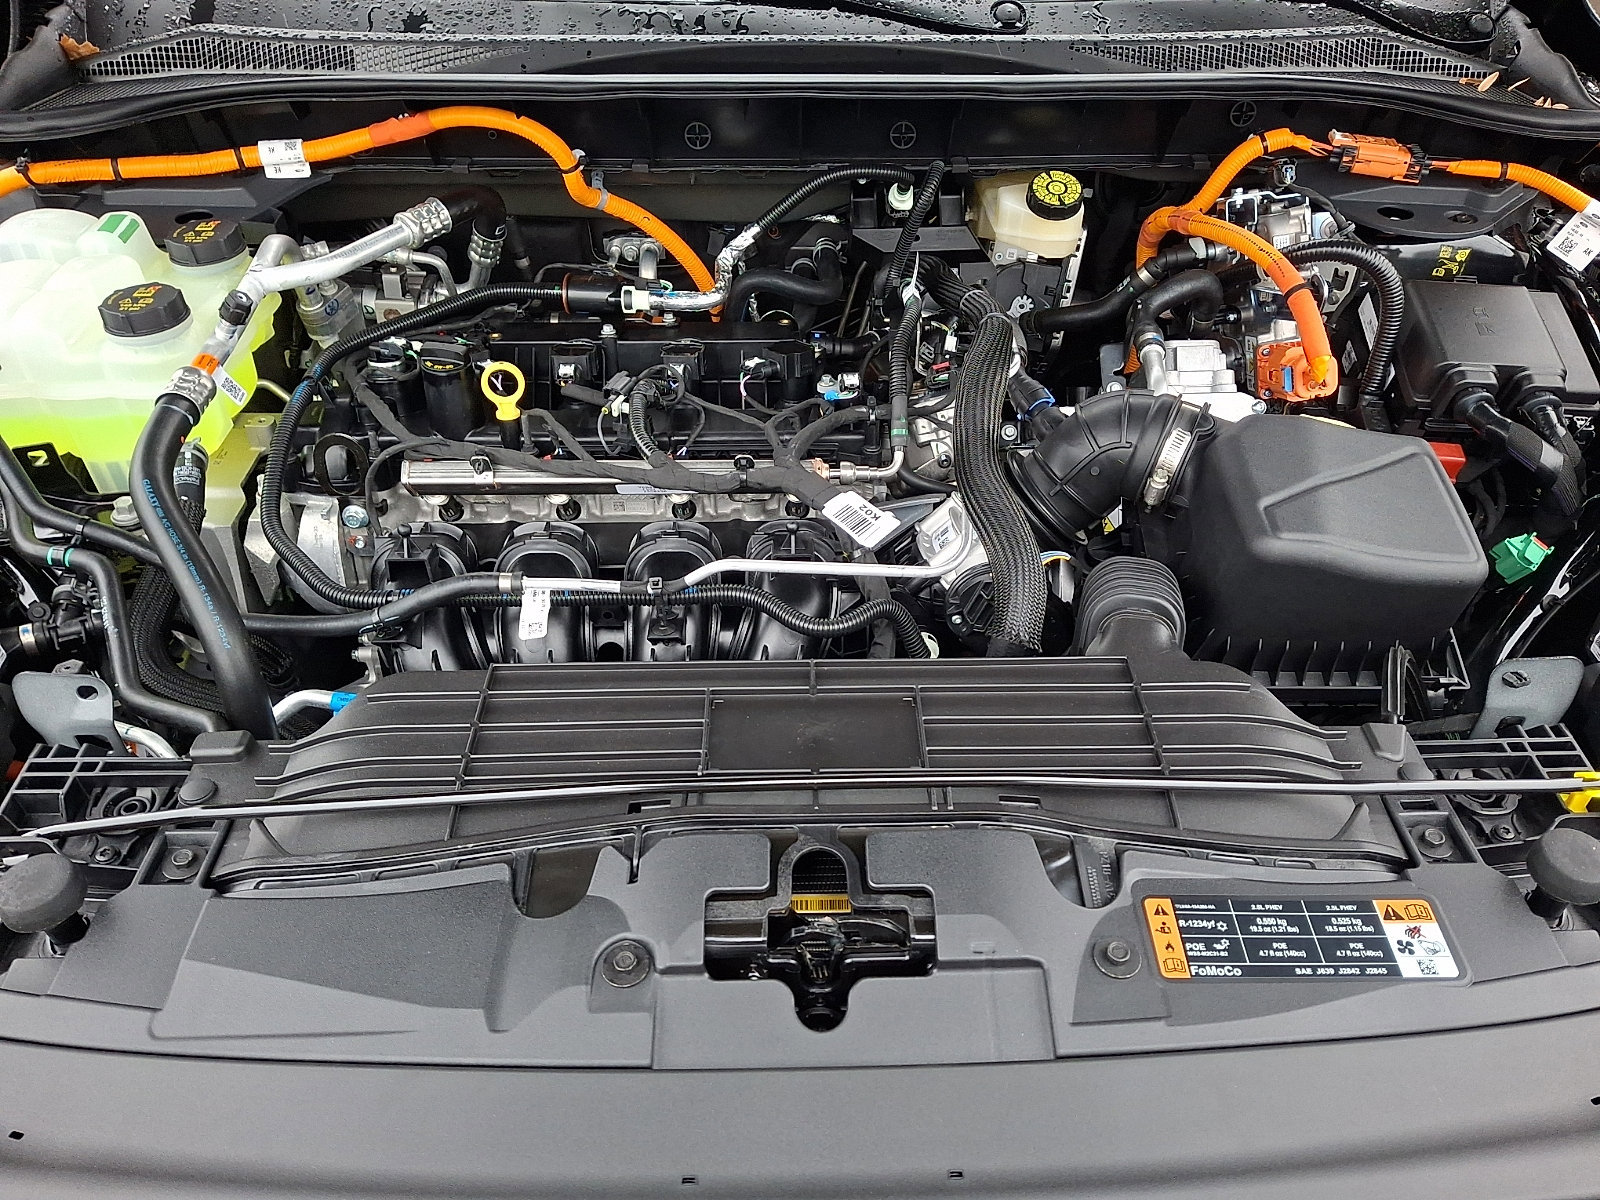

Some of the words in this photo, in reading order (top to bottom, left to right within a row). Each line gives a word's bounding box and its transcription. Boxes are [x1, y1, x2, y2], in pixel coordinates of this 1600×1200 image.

[859, 504, 881, 521] K02
[142, 479, 161, 507] GALAXY
[167, 527, 181, 544] HOSE
[185, 560, 202, 584] (19mm)
[199, 584, 214, 611] R-134a
[1179, 919, 1216, 930] R-1234yf
[1276, 917, 1287, 927] kg
[1351, 917, 1362, 926] kg
[1185, 942, 1206, 950] POE
[1272, 942, 1288, 950] POE
[1348, 942, 1364, 950] POE
[1283, 950, 1306, 958] (140cc)
[1191, 965, 1243, 976] FoMoCo
[1295, 967, 1313, 975] SAE
[1316, 967, 1335, 975] J639
